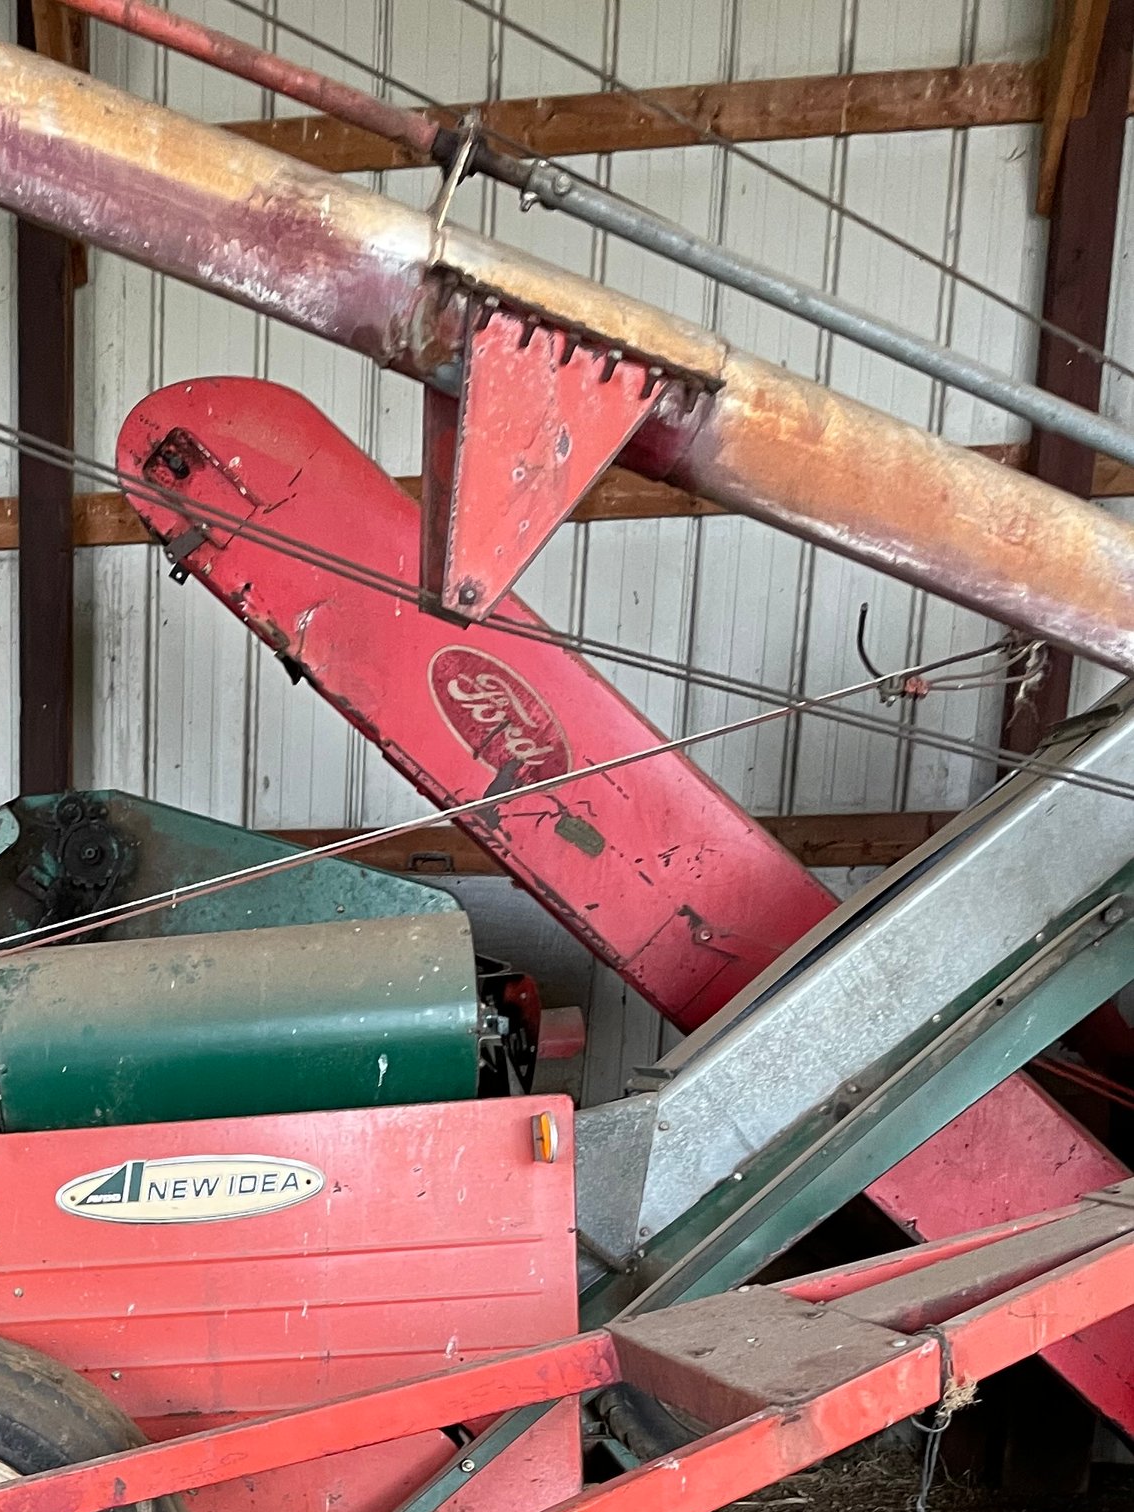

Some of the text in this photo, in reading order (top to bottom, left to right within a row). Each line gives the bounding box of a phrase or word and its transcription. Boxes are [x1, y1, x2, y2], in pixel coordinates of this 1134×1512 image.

[447, 673, 555, 766] Ford
[147, 1172, 300, 1201] NEW IDEA
